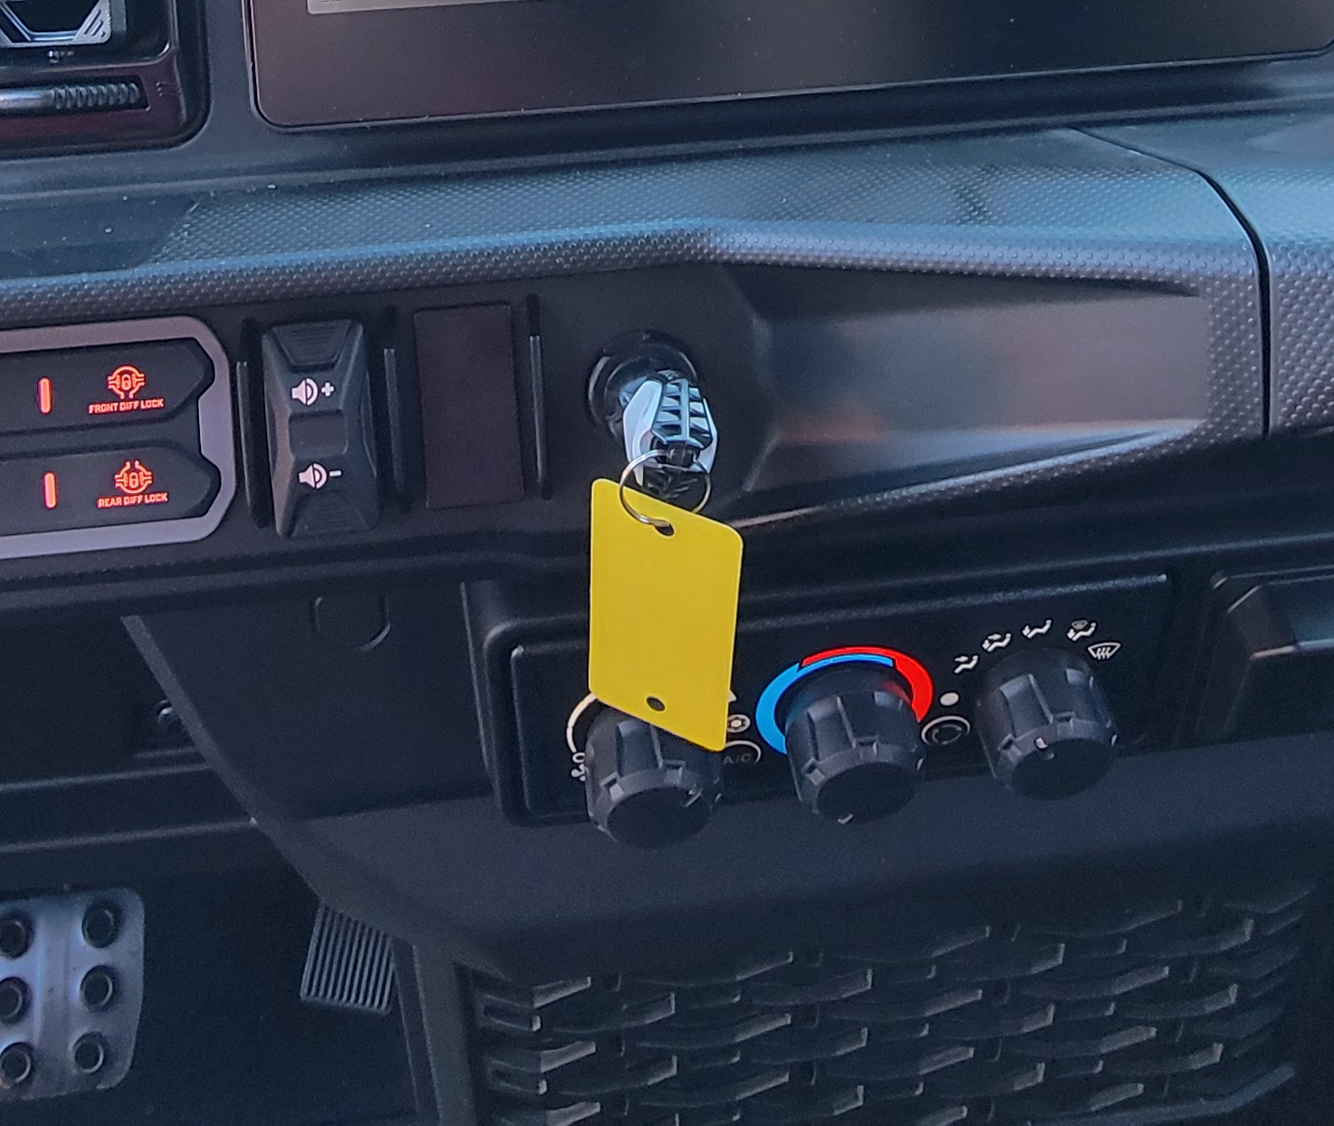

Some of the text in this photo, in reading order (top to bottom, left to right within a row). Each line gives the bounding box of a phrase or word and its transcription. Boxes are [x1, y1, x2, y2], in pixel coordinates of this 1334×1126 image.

[88, 398, 165, 414] FRONT DIFF LOCK
[97, 492, 169, 509] REAR DIFF LOCK
